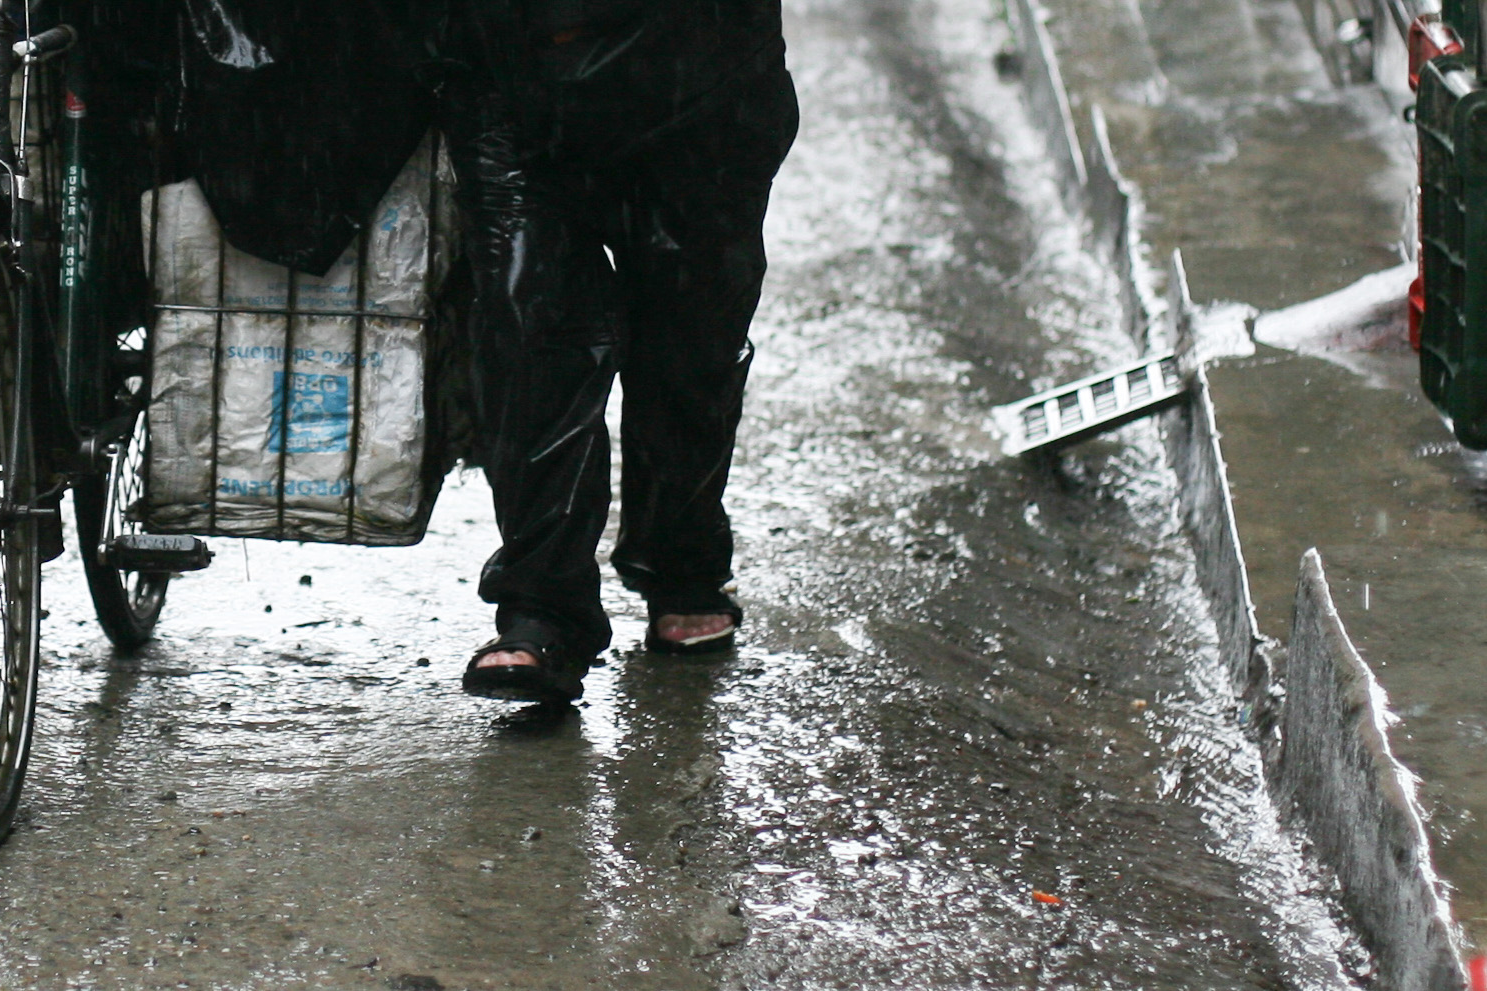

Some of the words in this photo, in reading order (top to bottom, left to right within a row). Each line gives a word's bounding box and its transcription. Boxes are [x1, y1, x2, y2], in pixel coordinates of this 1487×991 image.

[67, 165, 77, 216] SUPER
[64, 226, 75, 287] RONG
[227, 346, 315, 364] aditions
